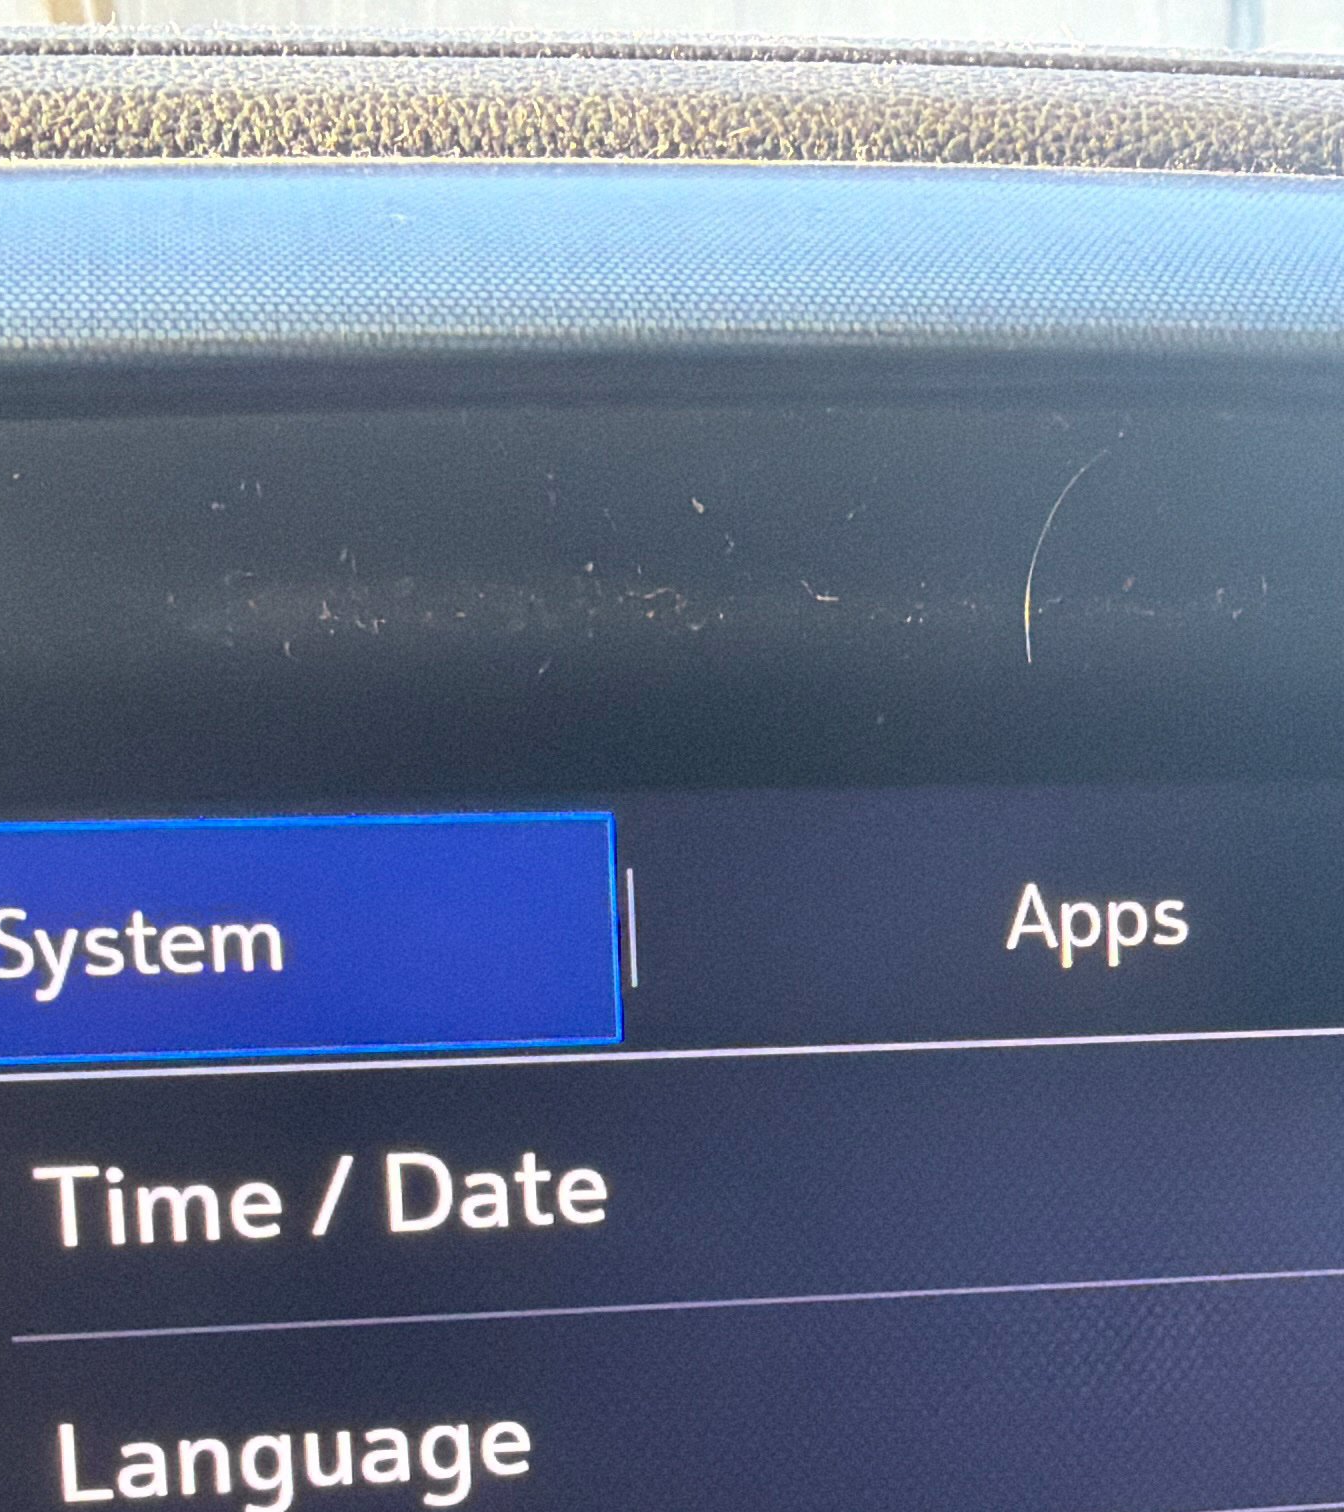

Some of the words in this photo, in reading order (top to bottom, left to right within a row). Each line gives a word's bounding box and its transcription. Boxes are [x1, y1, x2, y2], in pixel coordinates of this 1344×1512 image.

[1003, 880, 1192, 971] Apps
[30, 1162, 285, 1250] Time
[310, 1153, 355, 1239] /
[383, 1149, 610, 1235] Date
